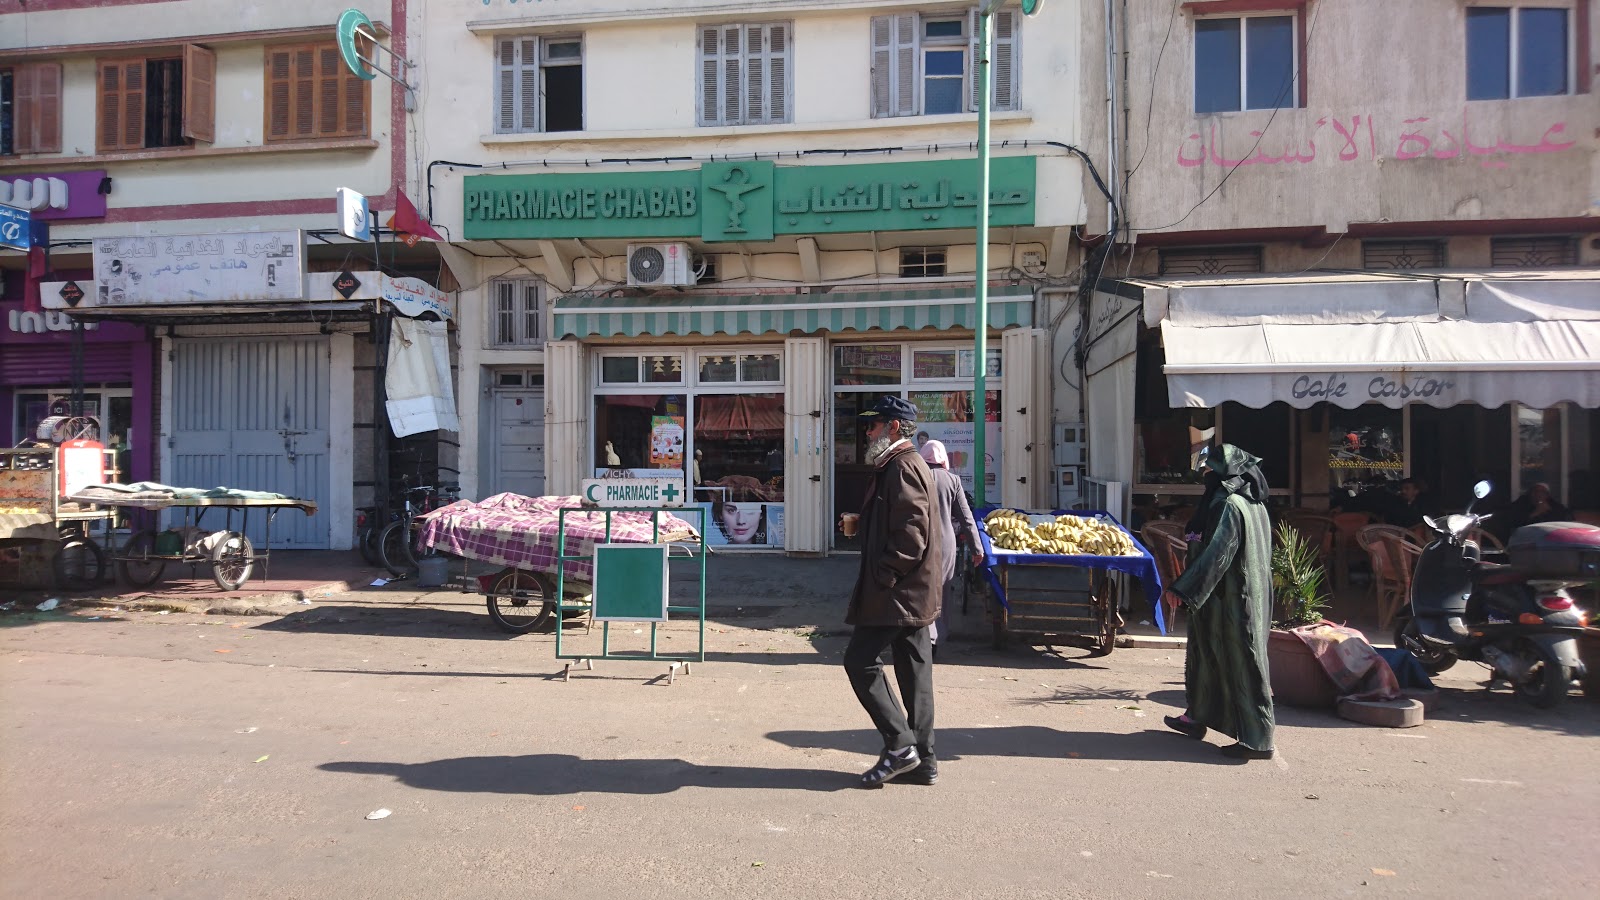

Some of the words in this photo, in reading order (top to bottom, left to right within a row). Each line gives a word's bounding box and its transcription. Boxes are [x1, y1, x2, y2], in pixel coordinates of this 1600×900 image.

[1395, 105, 1577, 168] عيادة
[466, 187, 598, 221] PHARMACIE
[600, 184, 698, 219] CHABAB
[779, 182, 892, 225] الشباب
[900, 177, 1029, 221] صدلية
[233, 236, 281, 258] المواد
[150, 262, 200, 278] عمومي
[209, 259, 248, 270] هاتف
[1367, 375, 1456, 399] Castor
[604, 470, 632, 478] VICHY
[607, 485, 659, 501] PHARMACIE
